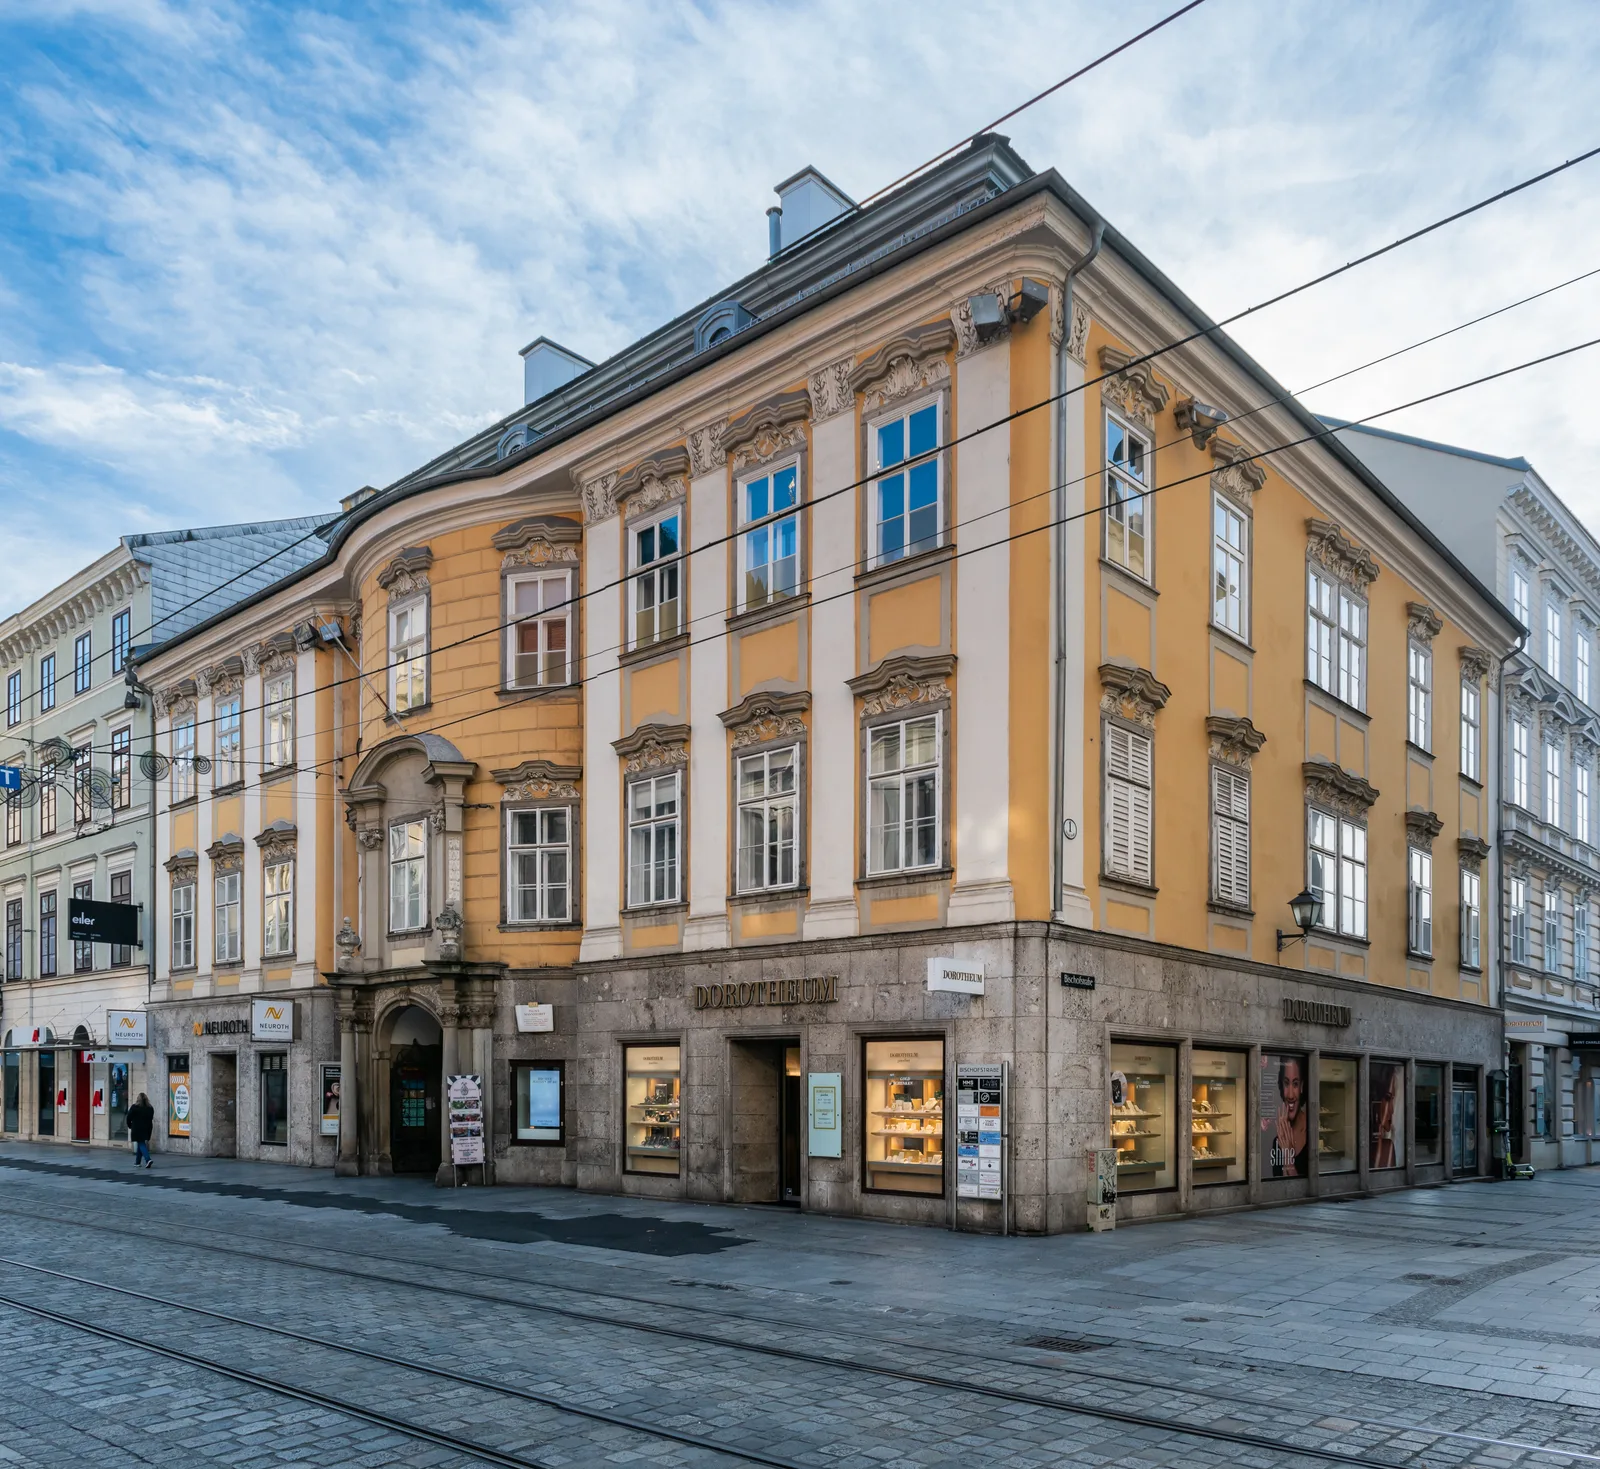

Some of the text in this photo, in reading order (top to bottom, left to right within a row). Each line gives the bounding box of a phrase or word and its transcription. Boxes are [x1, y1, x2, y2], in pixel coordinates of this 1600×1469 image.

[72, 911, 95, 925] eiler
[942, 970, 983, 983] DOROTHEUM
[1064, 974, 1093, 986] Bischofstraße
[694, 975, 839, 1009] DOROTHEUM
[1283, 997, 1352, 1026] DOROTHEUM
[204, 1019, 250, 1034] NEUROTH
[259, 1022, 290, 1030] NEUROTH
[87, 1053, 96, 1062] A1
[1270, 1138, 1295, 1166] shine
